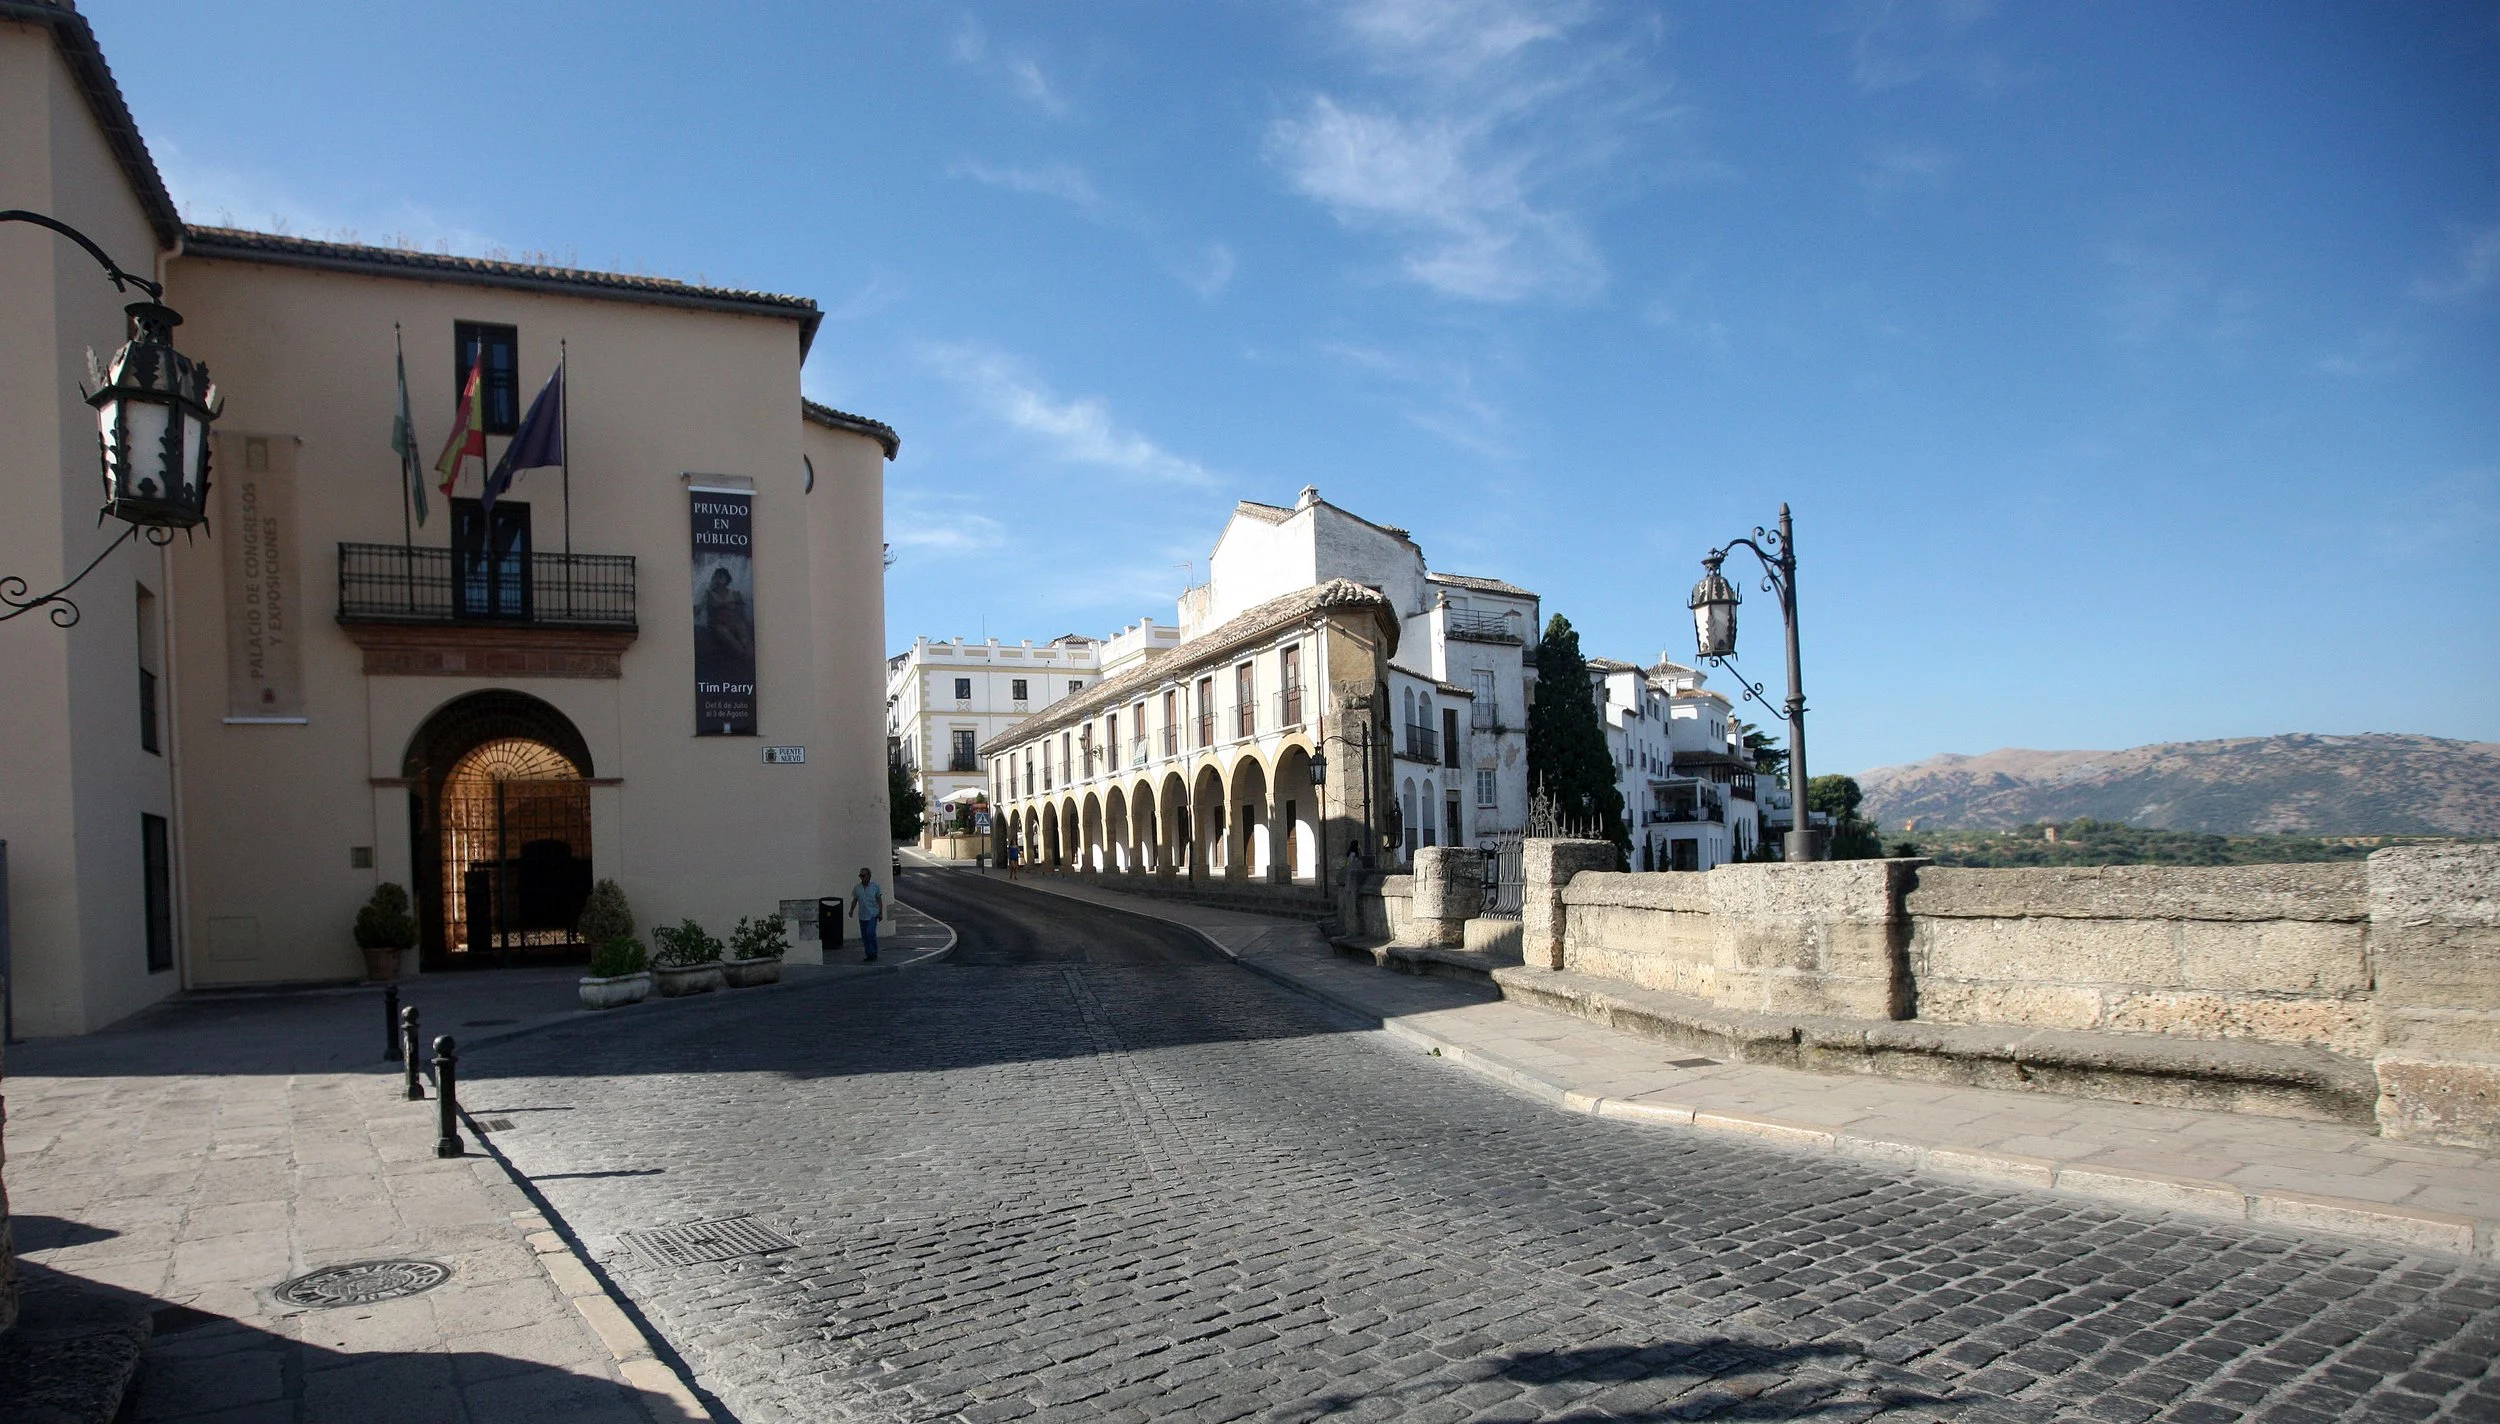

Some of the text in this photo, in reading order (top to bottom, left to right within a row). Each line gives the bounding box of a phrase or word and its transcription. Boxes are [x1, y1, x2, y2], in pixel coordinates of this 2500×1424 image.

[694, 503, 748, 516] PRIVADO
[714, 519, 729, 529] EN
[696, 531, 748, 546] PÚBLICO
[242, 482, 264, 679] PALACIO DE CONGRESOS
[263, 517, 282, 647] Y EXPOSICIONES
[698, 682, 754, 695] Tim Parry
[705, 701, 717, 709] Del
[723, 701, 732, 709] de
[733, 701, 749, 709] Julio
[726, 710, 749, 719] Agosto
